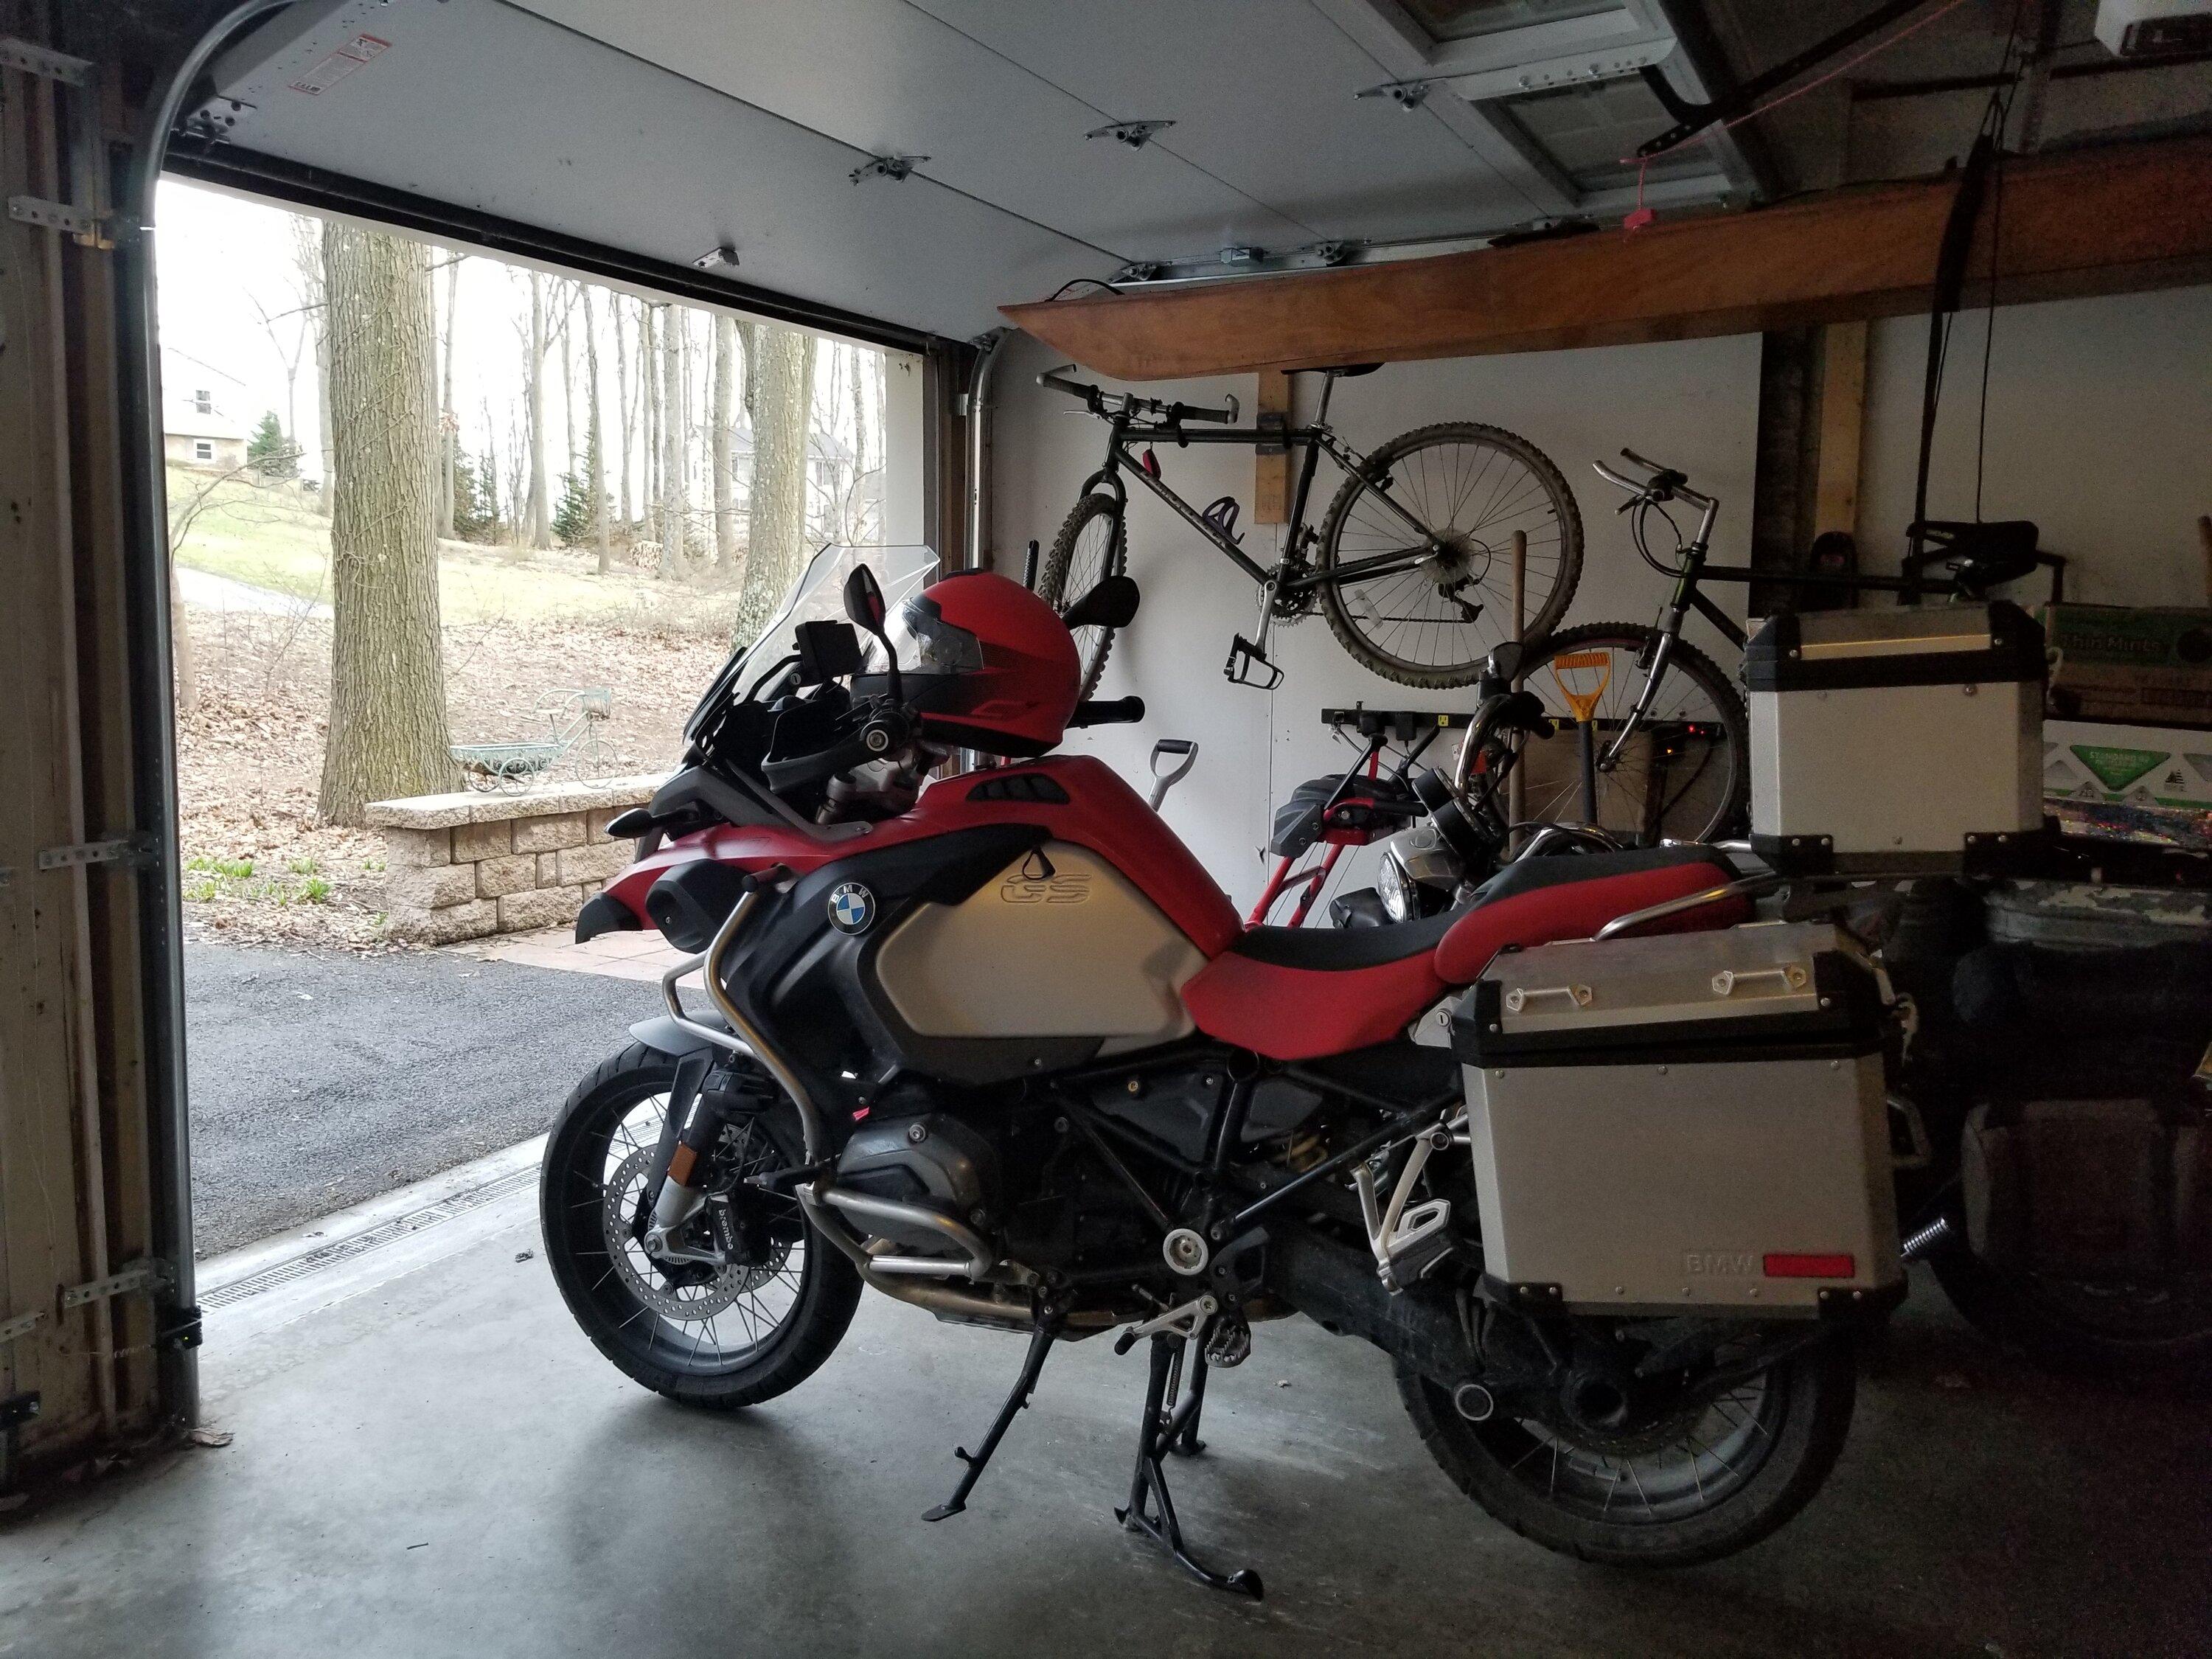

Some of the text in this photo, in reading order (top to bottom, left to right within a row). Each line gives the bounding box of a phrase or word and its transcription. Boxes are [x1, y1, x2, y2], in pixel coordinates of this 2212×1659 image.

[831, 884, 869, 904] BMW
[1001, 874, 1091, 903] GS
[718, 1208, 734, 1250] brembo
[1686, 1254, 1753, 1271] BMW
